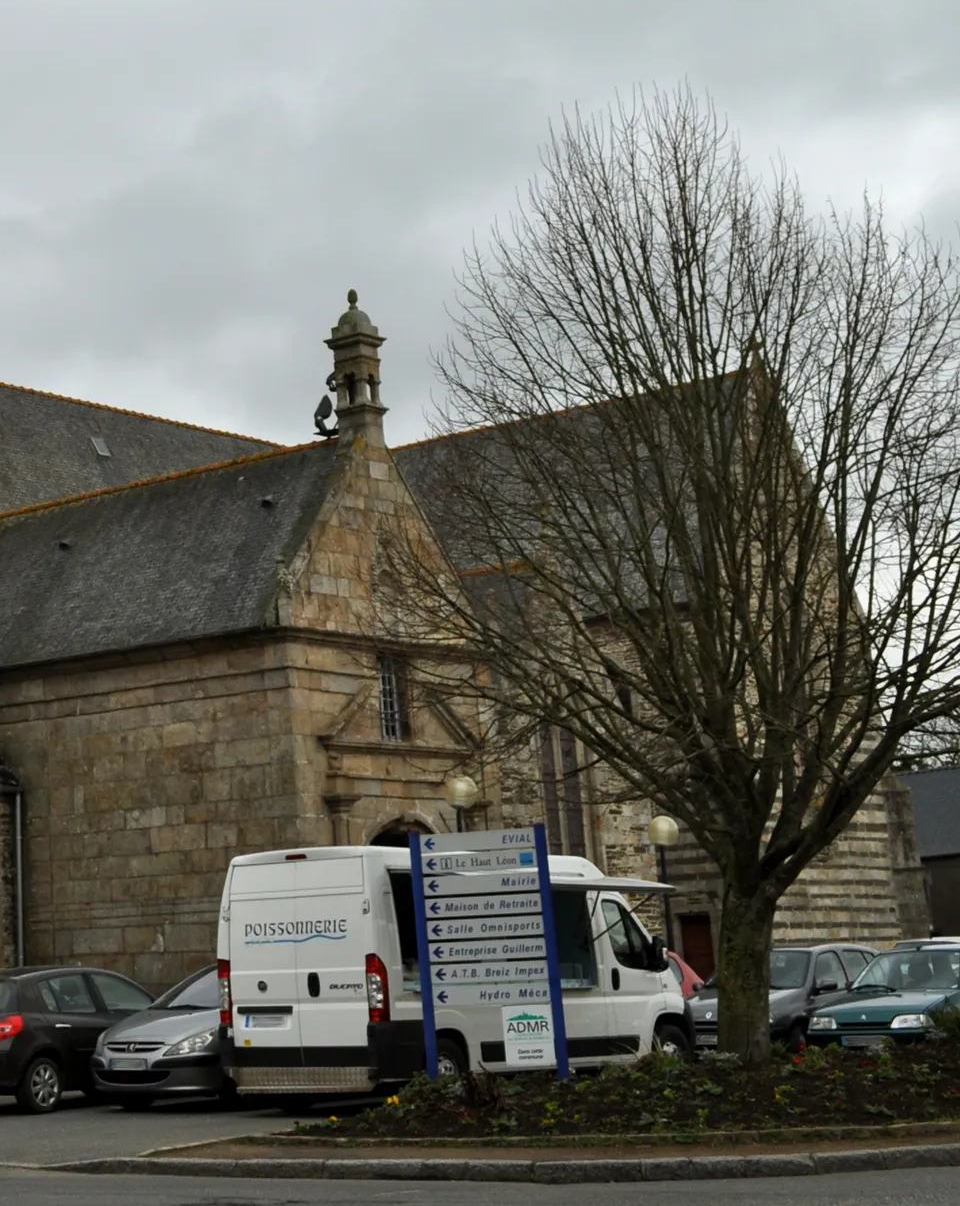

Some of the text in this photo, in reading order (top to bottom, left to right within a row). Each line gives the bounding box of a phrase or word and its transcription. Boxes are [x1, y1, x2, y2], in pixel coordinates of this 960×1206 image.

[501, 833, 532, 844] EVIAL
[455, 858, 467, 868] Le
[470, 856, 493, 867] Haut
[501, 877, 536, 887] Mairie
[444, 898, 539, 912] Maison de Retraite
[244, 919, 348, 938] POISSONNERIE
[446, 920, 541, 935] Salle Omnisports
[448, 944, 544, 957] Entreprise Guillerm
[485, 967, 510, 977] Breiz
[515, 966, 545, 977] Impex
[479, 988, 548, 1001] Hydro Méca
[507, 1020, 549, 1034] ADMR
